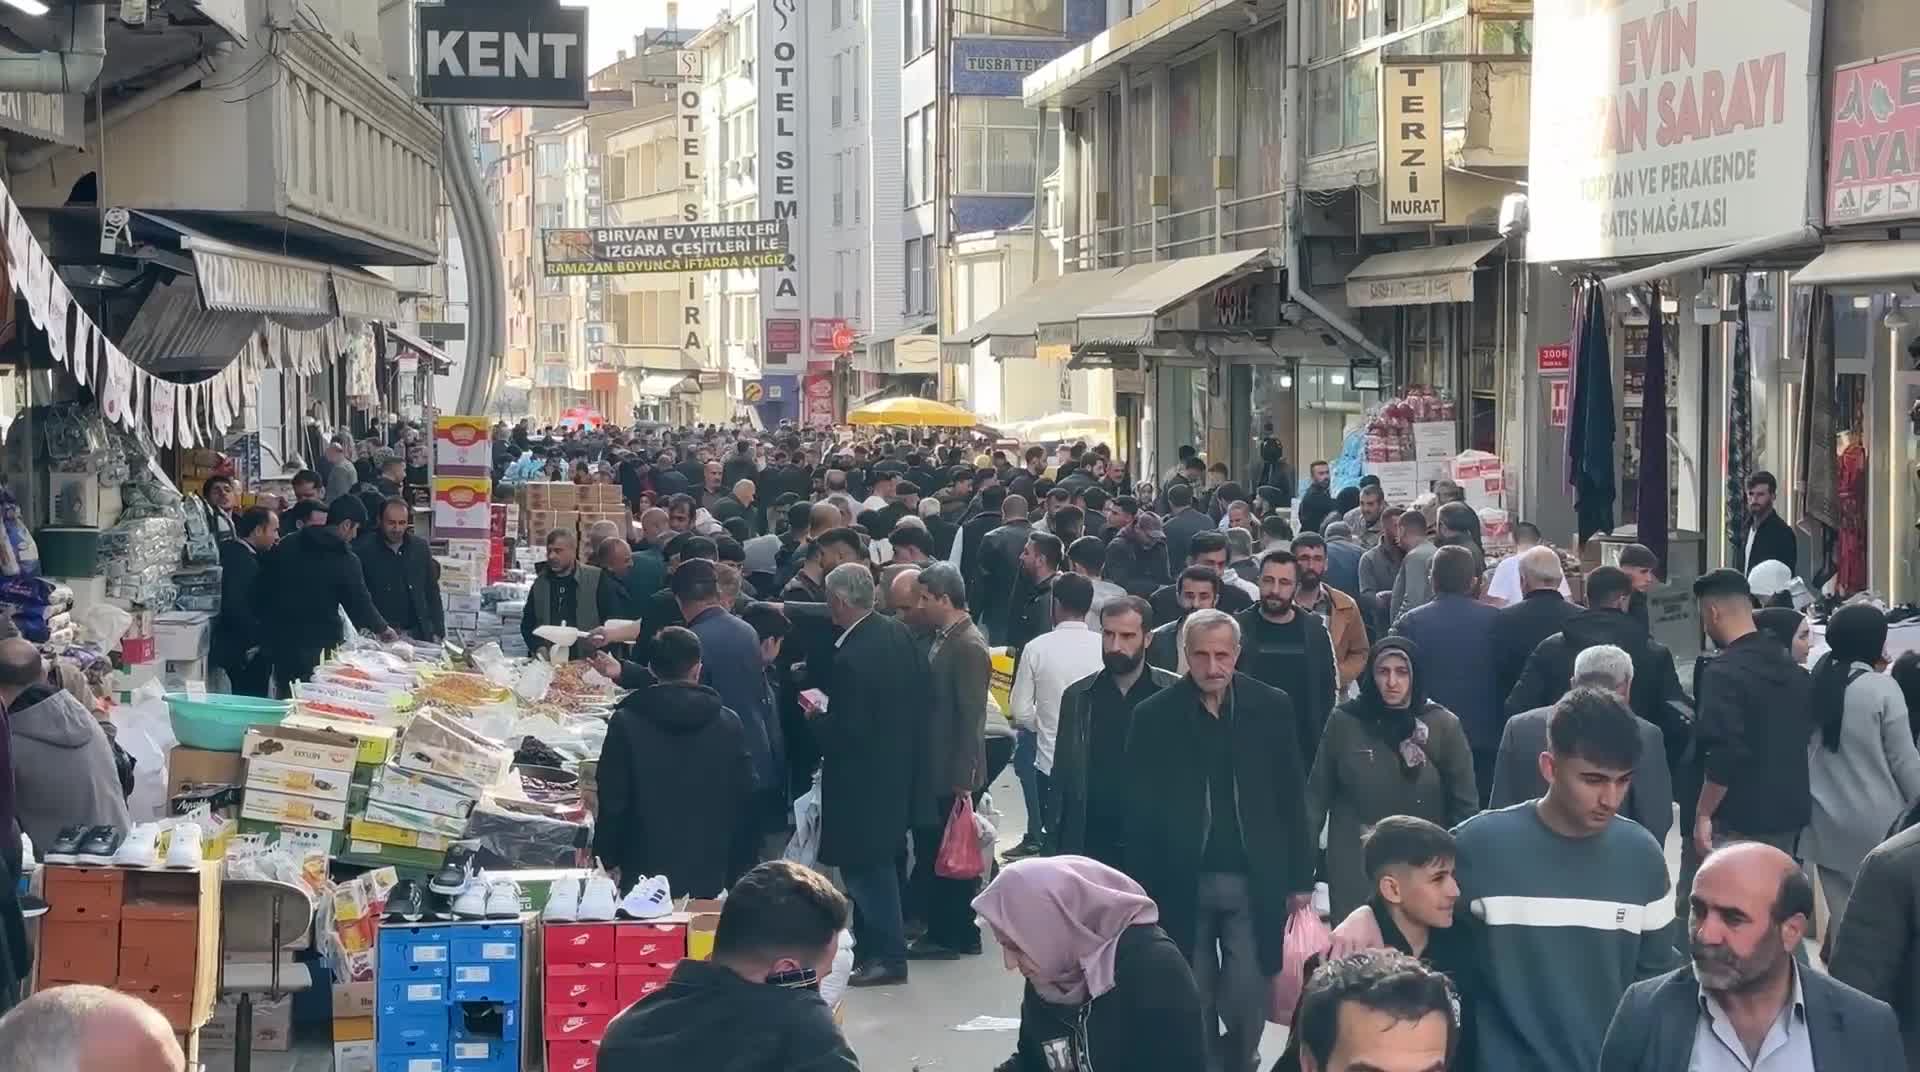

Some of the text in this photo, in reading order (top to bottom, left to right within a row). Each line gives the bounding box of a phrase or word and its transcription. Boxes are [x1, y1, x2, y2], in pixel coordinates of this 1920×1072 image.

[427, 30, 577, 79] KENT
[774, 42, 795, 137] OTEL
[1656, 52, 1786, 147] SARAYI
[681, 91, 700, 179] OTEL
[1399, 69, 1426, 193] TERZİ
[1638, 167, 1657, 194] VE
[1661, 149, 1757, 193] PERAKENDE
[1840, 130, 1920, 182] AYA
[663, 228, 684, 240] EV
[690, 221, 781, 239] YEMEKLERİ
[774, 151, 797, 297] SEMRA
[1391, 200, 1440, 214] MURAT
[1642, 197, 1728, 234] MAĞAZASI
[547, 262, 613, 275] RAMAZAN
[617, 256, 681, 273] BOYUNCA
[685, 254, 739, 270] İFTARDA
[605, 244, 666, 258] IZGARA
[755, 235, 779, 251] İLE
